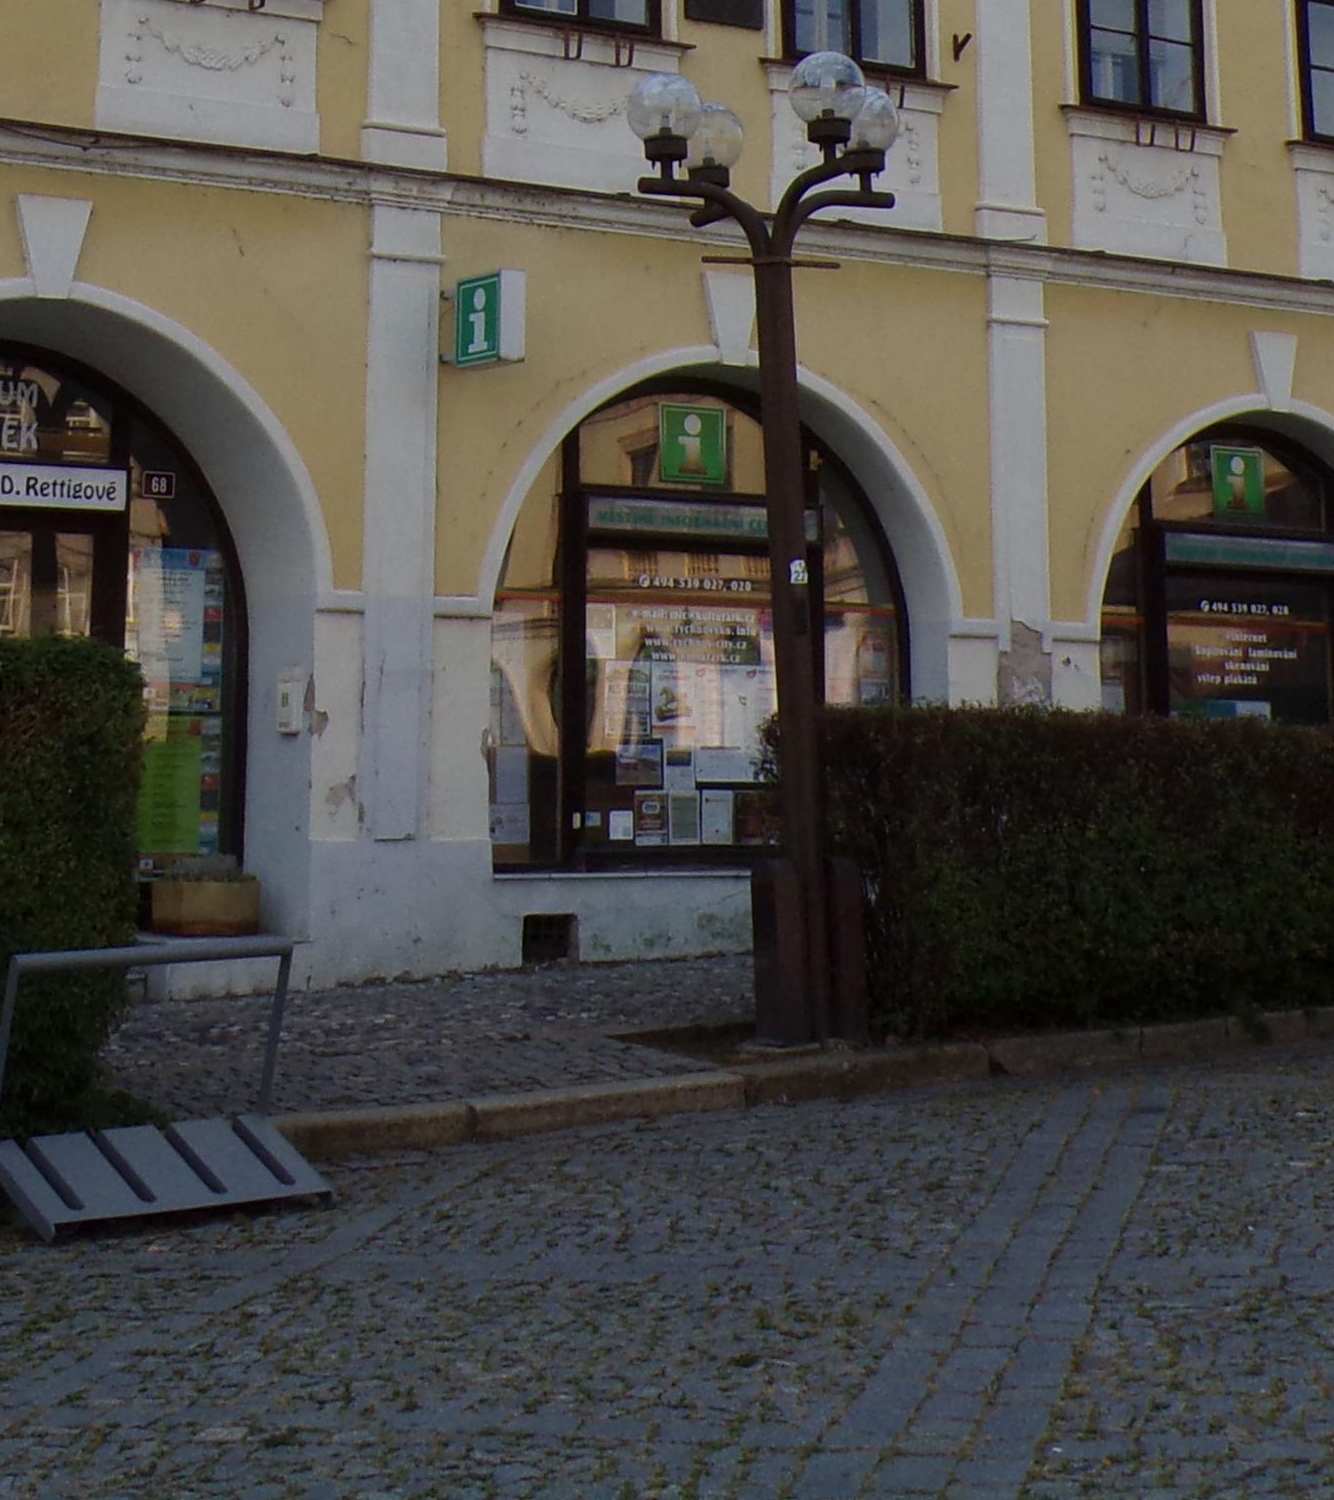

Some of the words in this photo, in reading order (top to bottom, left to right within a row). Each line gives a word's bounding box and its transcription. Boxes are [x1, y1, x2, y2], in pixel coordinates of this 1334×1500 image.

[26, 476, 117, 501] Rettigové
[151, 476, 167, 494] 68
[653, 575, 674, 588] 494
